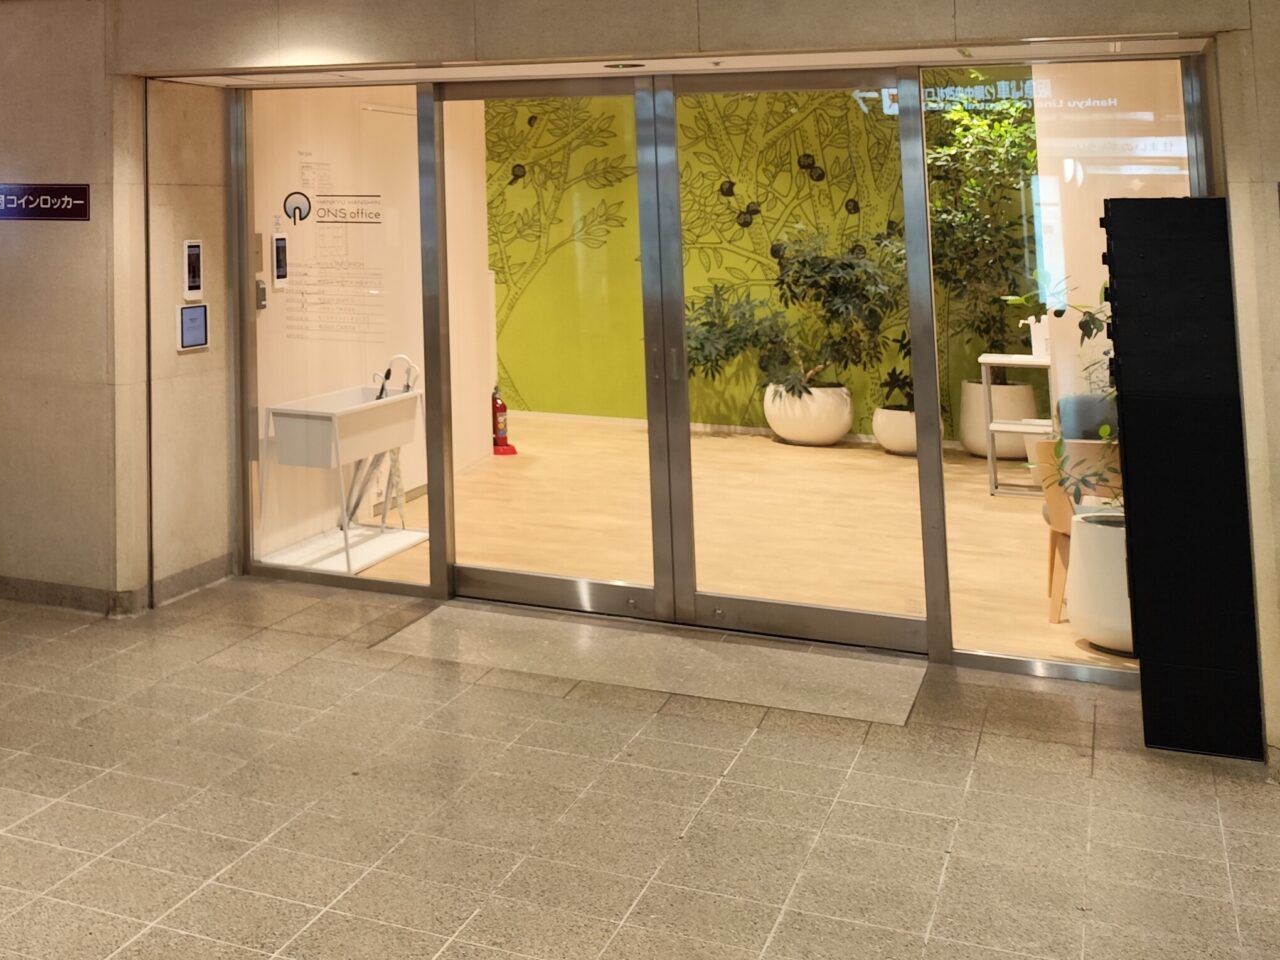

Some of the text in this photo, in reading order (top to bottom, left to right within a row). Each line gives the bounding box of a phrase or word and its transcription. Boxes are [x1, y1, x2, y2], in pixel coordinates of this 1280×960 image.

[6, 195, 85, 209] コインロッカー
[316, 207, 381, 219] ONS office
